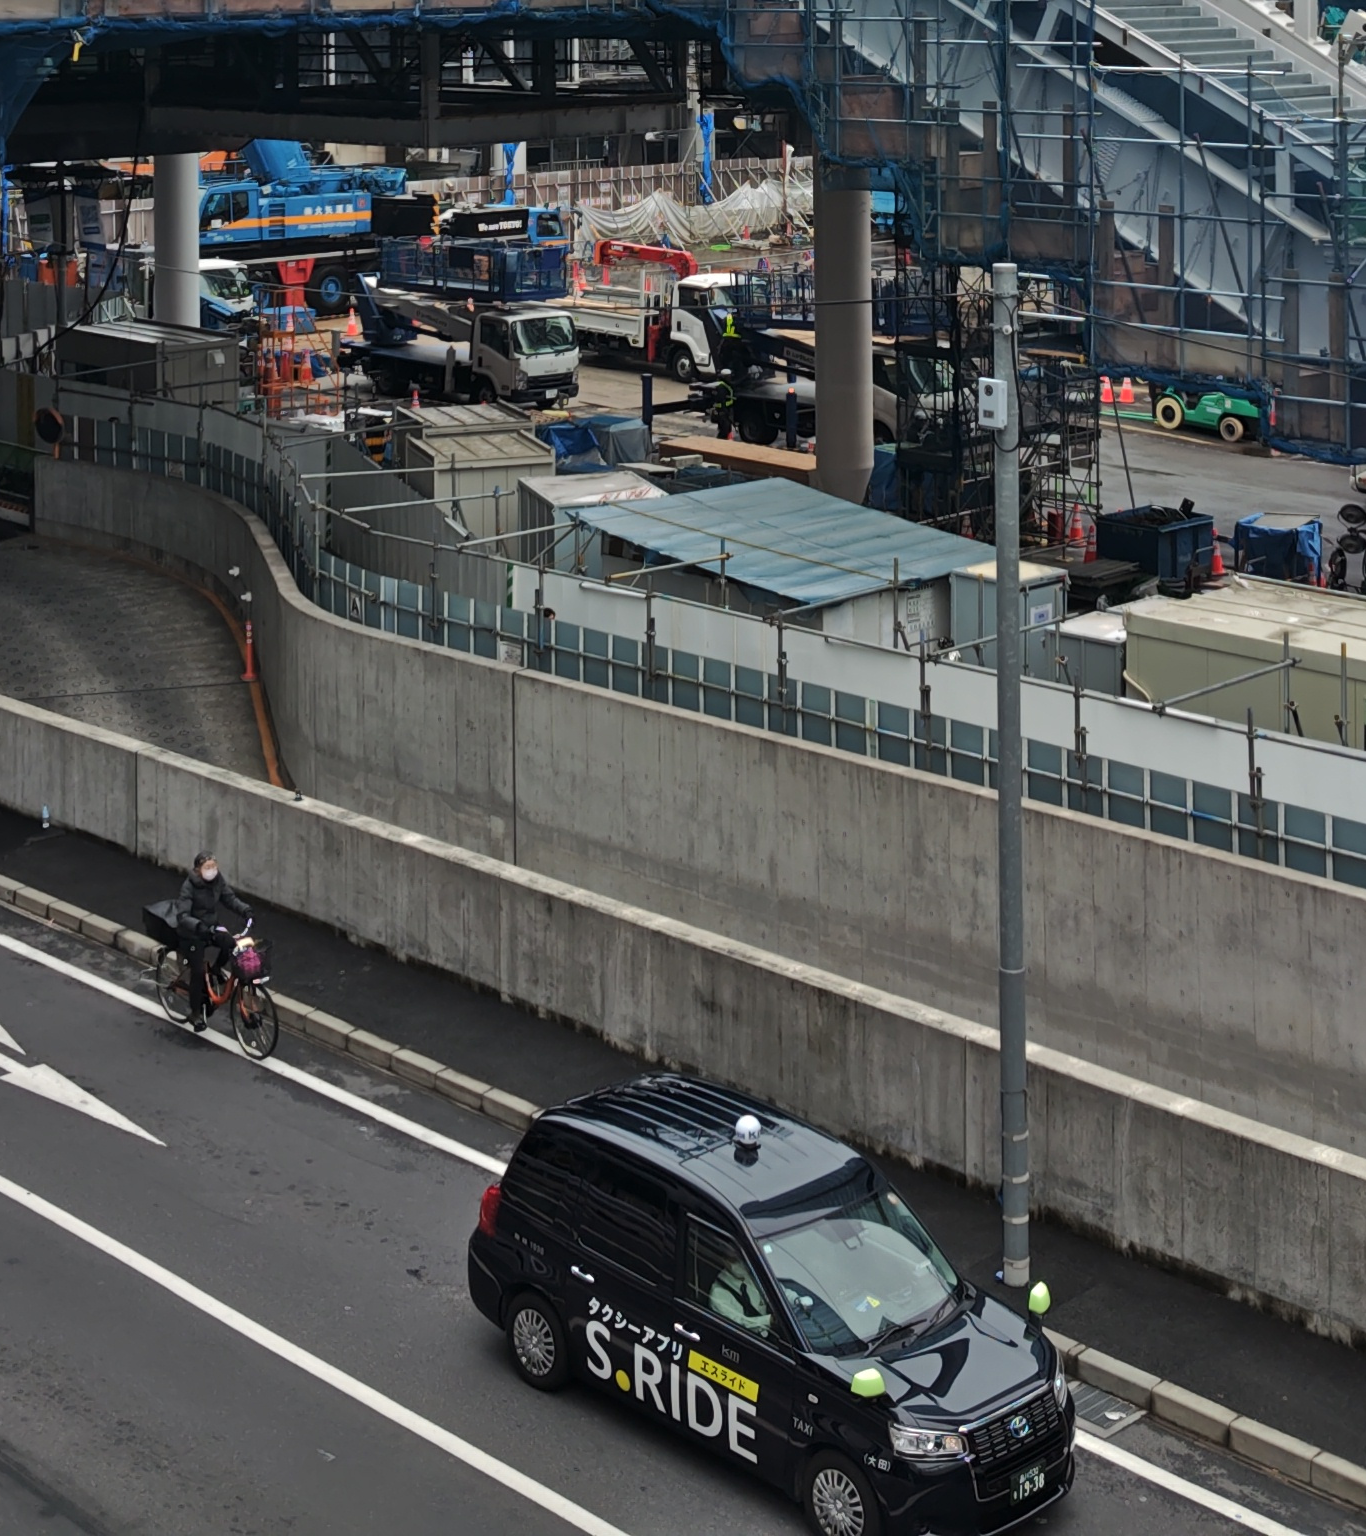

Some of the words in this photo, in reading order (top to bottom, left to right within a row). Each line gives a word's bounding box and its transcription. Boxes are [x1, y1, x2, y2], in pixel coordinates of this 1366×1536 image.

[588, 1297, 683, 1361] タクシーアプリ
[586, 1320, 758, 1464] S.RIDE
[700, 1360, 746, 1392] エスライド
[792, 1417, 813, 1437] TAXI
